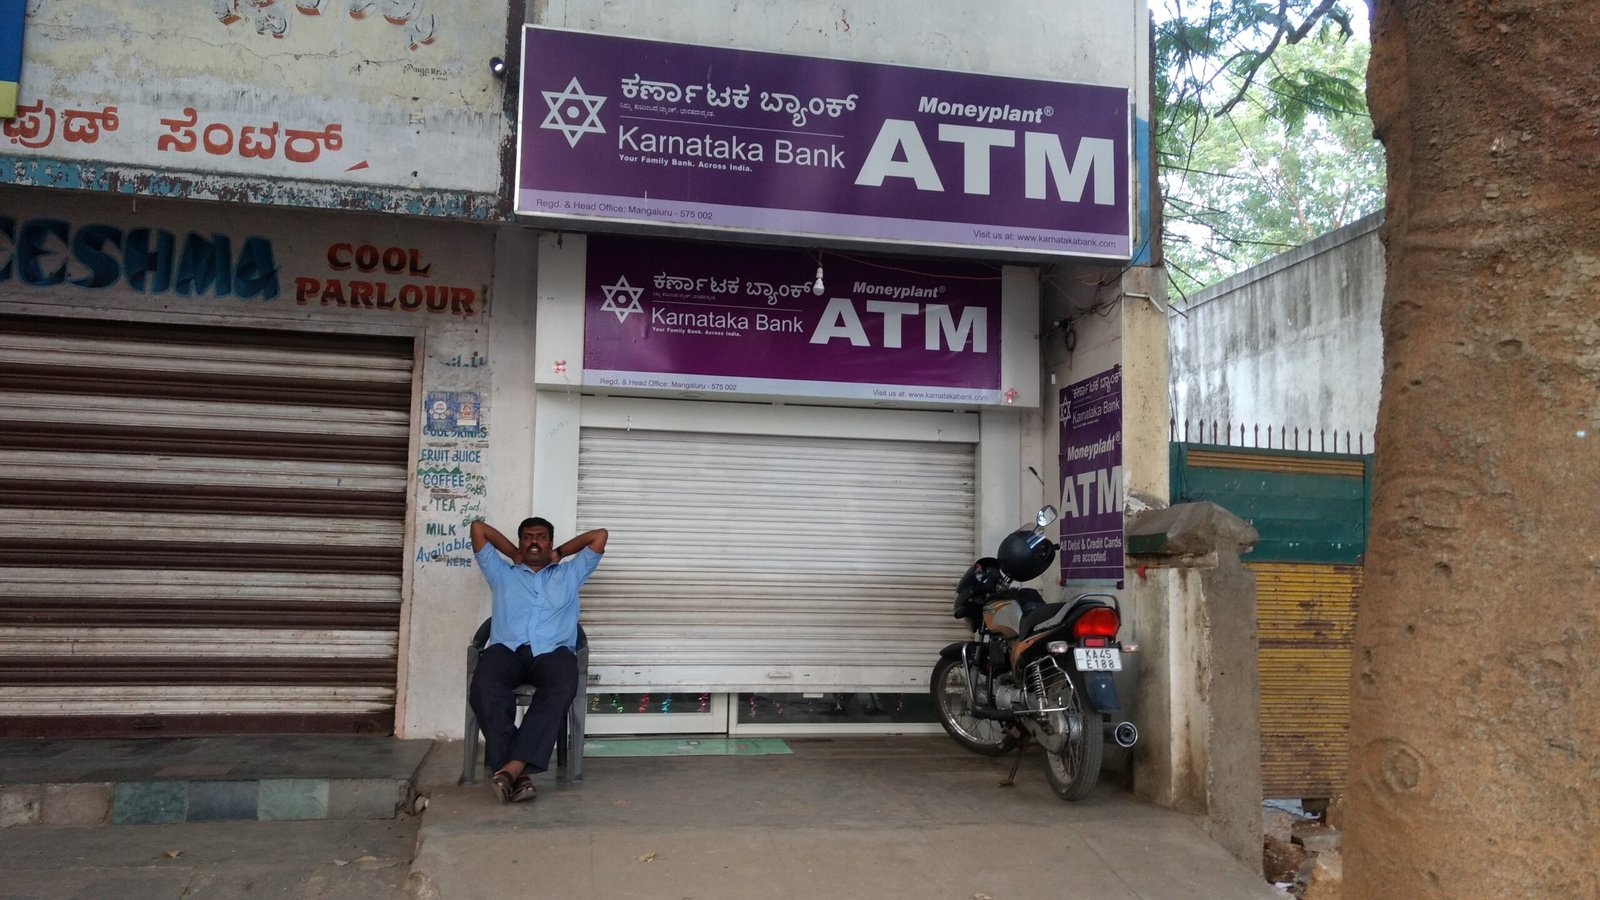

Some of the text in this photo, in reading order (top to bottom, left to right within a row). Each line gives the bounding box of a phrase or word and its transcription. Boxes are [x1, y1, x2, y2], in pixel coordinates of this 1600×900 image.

[621, 73, 859, 128] ಕರ್ಣಾಟಕ ಬ್ಯಾಂಕ್
[158, 107, 344, 164] ಸೆಂಟರ್
[618, 125, 846, 169] Karnataka Bank
[619, 154, 753, 172] Your Family Bank. Across India.
[854, 118, 1115, 206] ATM
[536, 198, 562, 210] Regd.
[564, 200, 571, 209] &
[573, 201, 597, 211] Head
[598, 202, 626, 214] Office:
[628, 205, 673, 219] Mangaluru
[680, 210, 696, 219] 575
[698, 211, 713, 220] 002
[973, 229, 1116, 248] Visit us at: www.karnatakabank.com
[327, 242, 432, 277] COOL
[295, 277, 476, 317] PARLOUR
[653, 271, 813, 305] ಕರ್ಣಾಟಕ ಬ್ಯಾಂಕ್
[651, 307, 803, 333] Karnataka Bank
[667, 327, 686, 335] Family
[809, 297, 987, 353] ATM
[628, 379, 647, 387] Head
[648, 379, 669, 388] Office:
[671, 381, 706, 391] Mangaluru
[711, 383, 723, 391] 575
[873, 388, 887, 397] Visit
[908, 391, 989, 402] www.karnatakabank.com
[1072, 405, 1102, 424] Karnataka
[1103, 397, 1121, 415] Bank
[421, 448, 481, 463] FRUIT JUICE
[423, 473, 464, 487] COFFEE
[1060, 465, 1122, 520] ATM
[435, 498, 456, 512] TEA
[426, 523, 456, 536] MILK
[416, 538, 473, 562] Available
[1081, 538, 1086, 549] &
[1086, 537, 1103, 549] Credit
[1104, 536, 1122, 548] Cards
[1072, 554, 1081, 563] are
